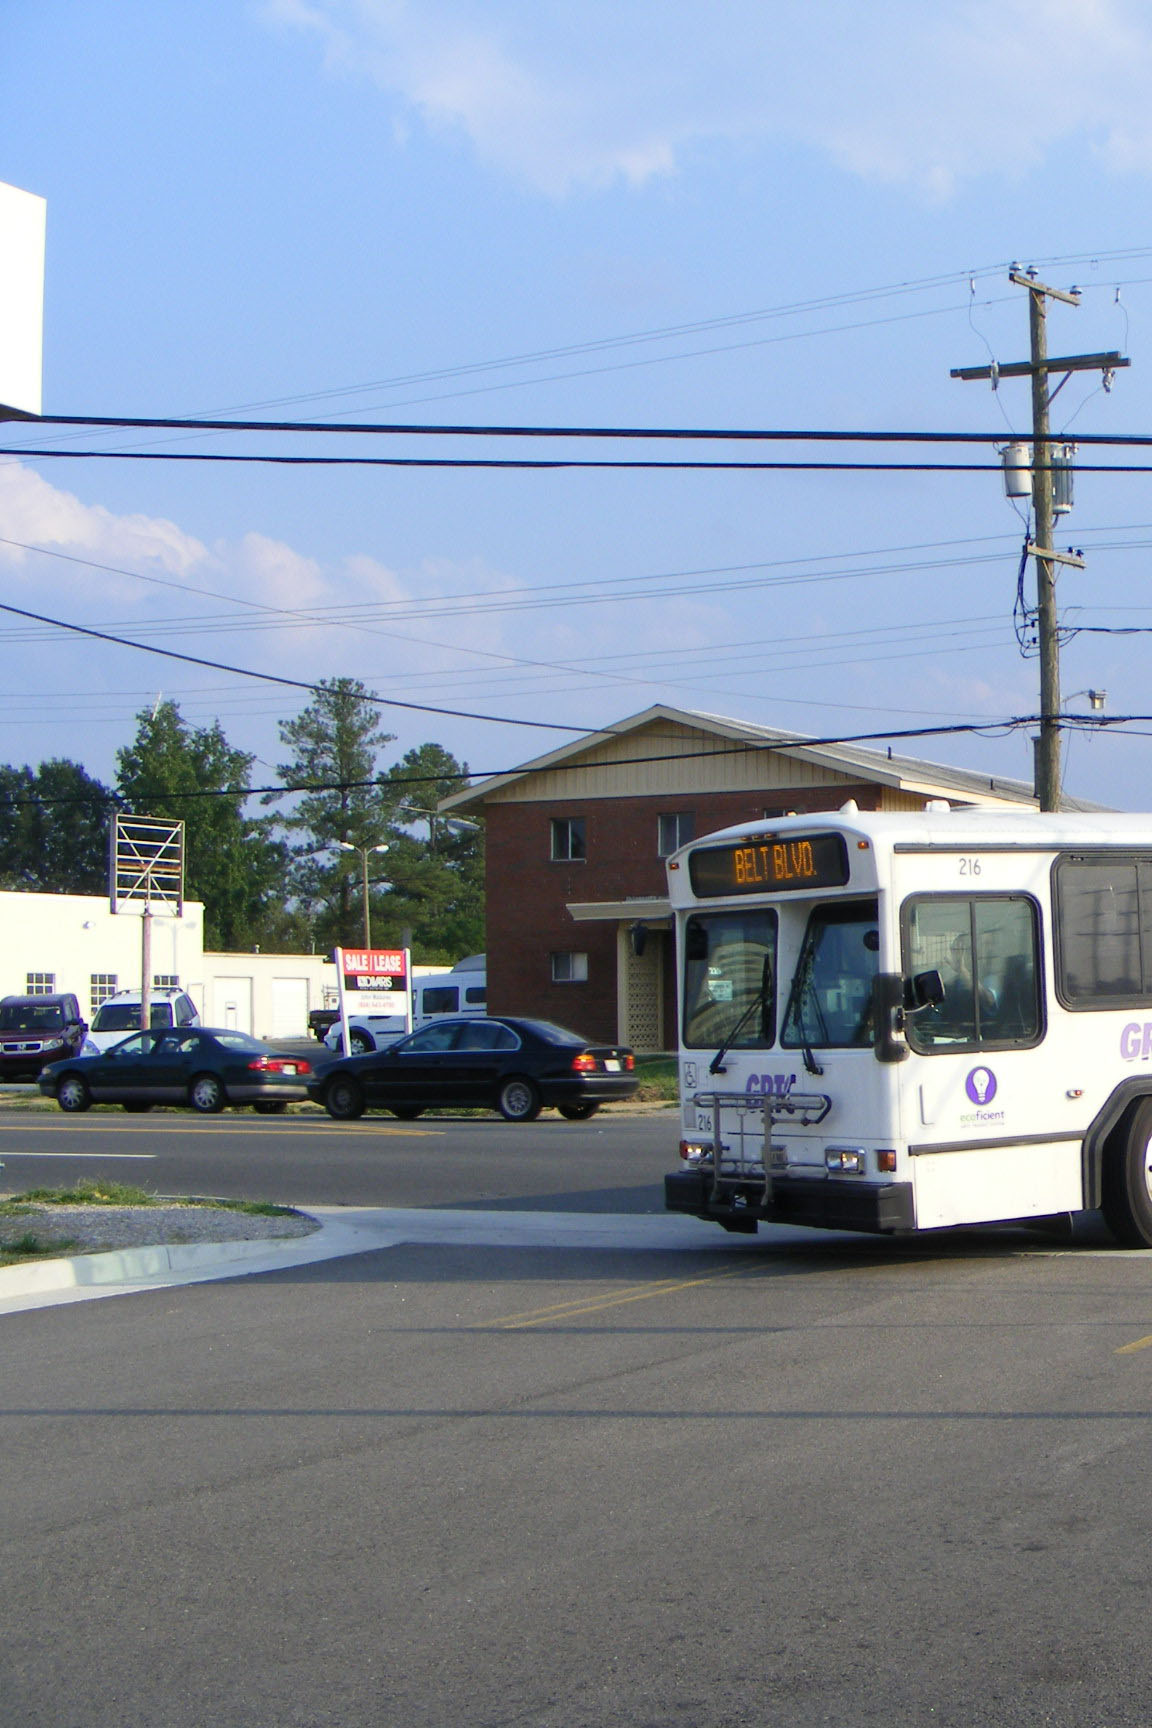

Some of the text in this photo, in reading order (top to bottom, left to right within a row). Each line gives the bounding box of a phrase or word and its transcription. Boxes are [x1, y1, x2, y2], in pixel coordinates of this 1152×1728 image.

[734, 841, 818, 884] BELT BLVD.
[959, 857, 981, 876] 216
[345, 954, 369, 971] SALE
[374, 954, 401, 972] LEASE
[698, 1114, 712, 1131] 216
